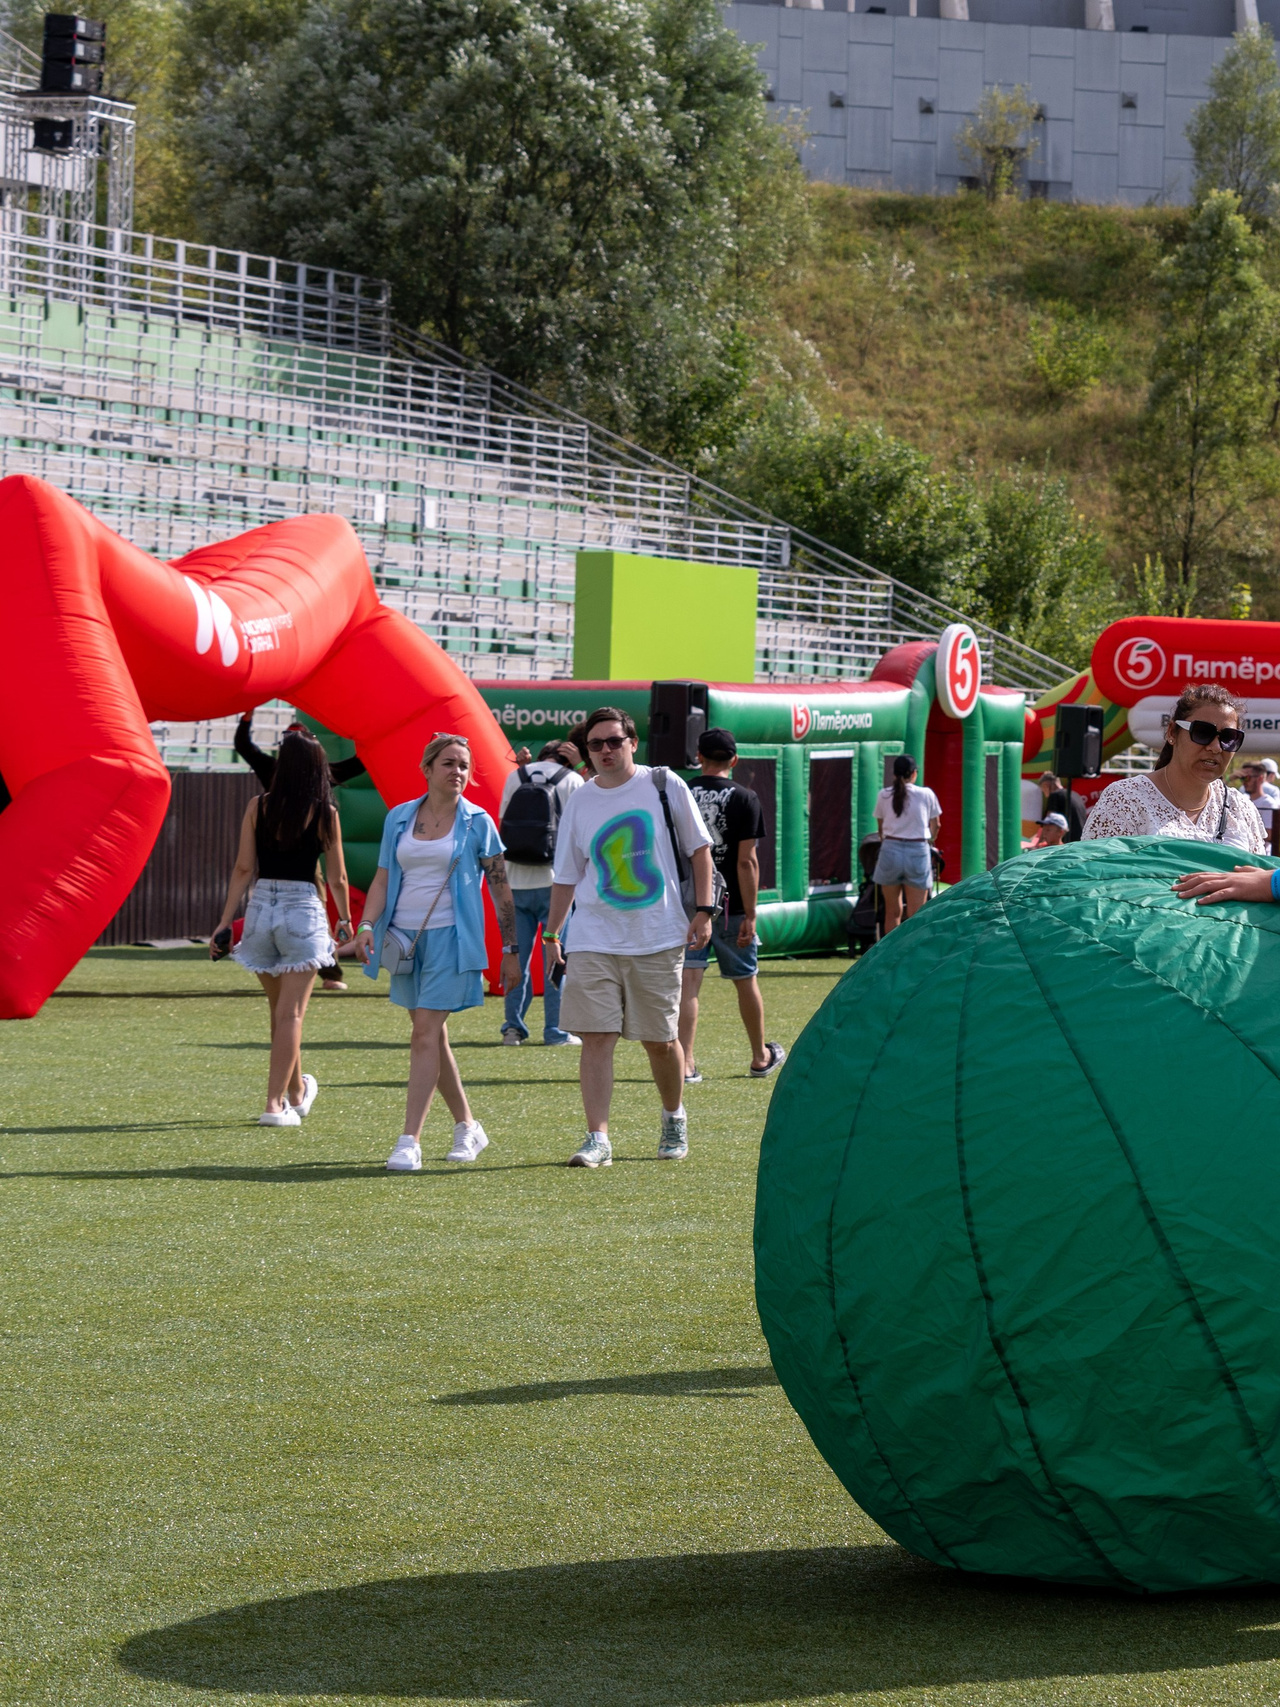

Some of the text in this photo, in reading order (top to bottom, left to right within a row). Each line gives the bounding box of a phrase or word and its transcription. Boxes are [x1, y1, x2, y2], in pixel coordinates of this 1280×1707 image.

[955, 634, 974, 700] 5
[1127, 641, 1154, 681] 5
[811, 709, 873, 735] Пятёрочка
